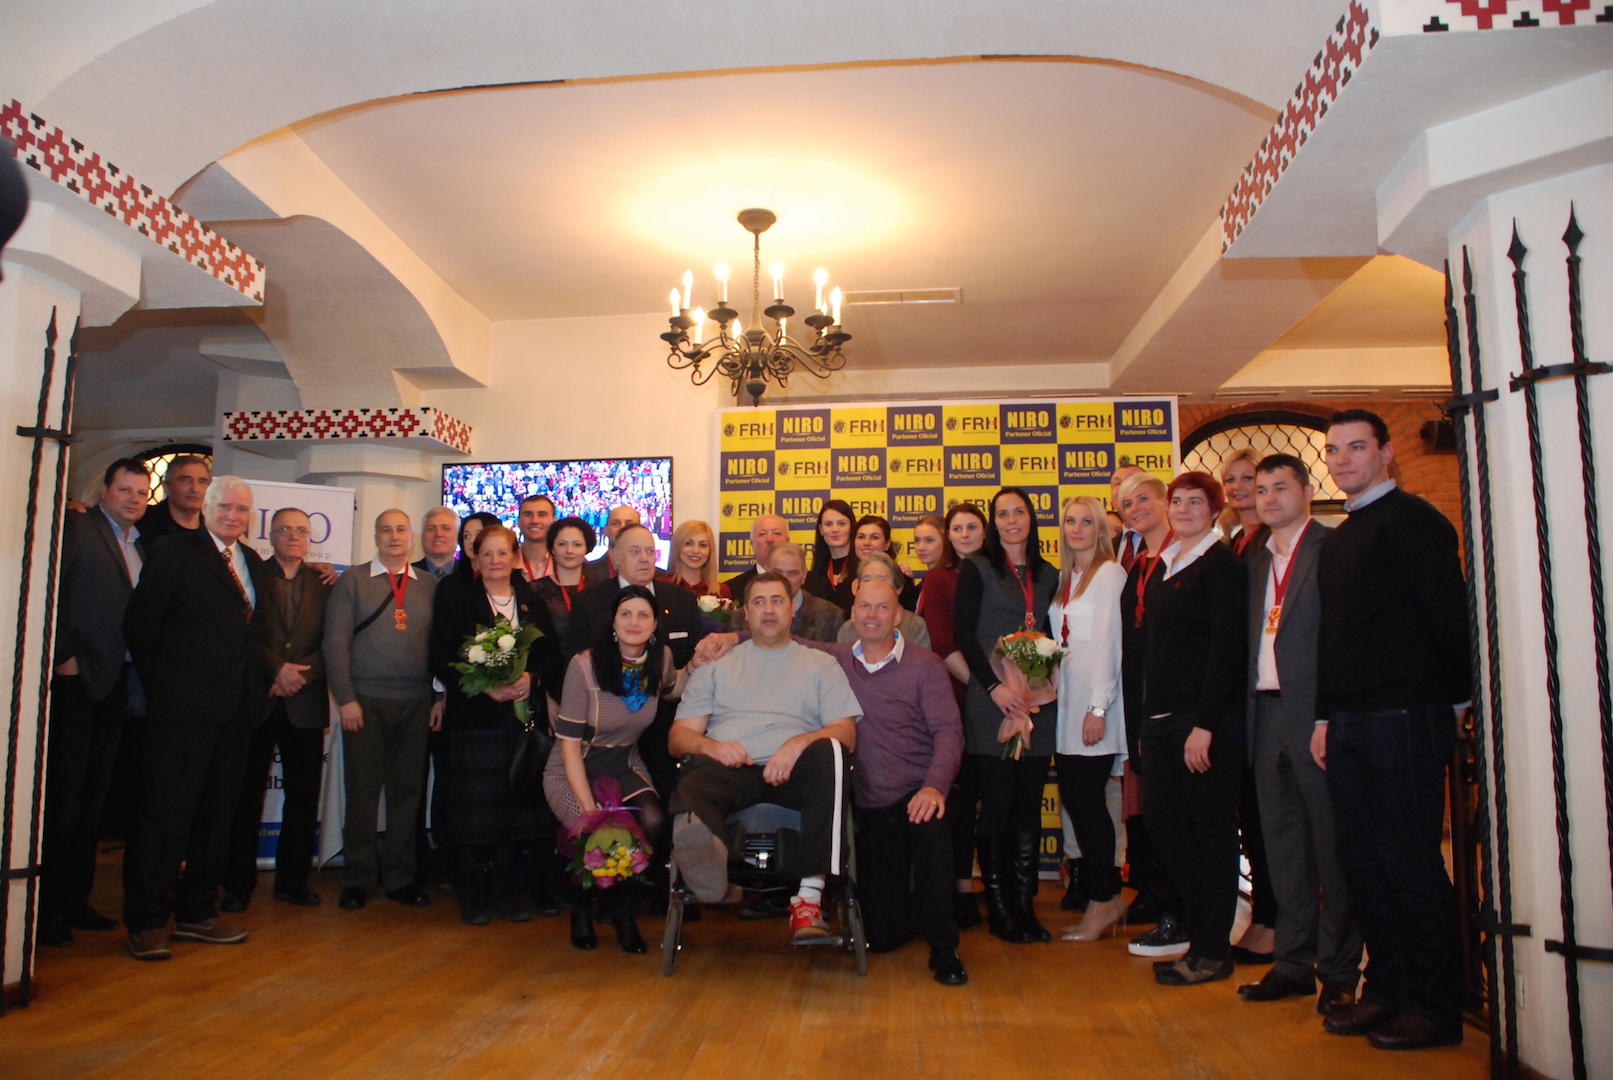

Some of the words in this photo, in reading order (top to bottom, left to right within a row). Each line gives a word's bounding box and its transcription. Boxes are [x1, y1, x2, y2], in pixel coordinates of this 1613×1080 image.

[783, 417, 823, 433] NIRO
[894, 413, 935, 430] NIRO
[963, 417, 997, 430] FRH
[1008, 411, 1048, 428] NIRO
[1077, 415, 1111, 428] FRH
[1122, 409, 1164, 426] NIRO
[740, 423, 773, 436] FRH
[850, 420, 884, 432] FRH
[728, 458, 767, 475] NIRO
[794, 461, 828, 474] FRH
[839, 455, 879, 472] NIRO
[907, 459, 941, 472] FRH
[951, 453, 992, 469] NIRO
[1021, 457, 1055, 470] FRH
[1066, 451, 1108, 468] NIRO
[1136, 455, 1171, 468] FRH
[782, 497, 823, 514] NIRO
[895, 495, 936, 512] NIRO
[1030, 493, 1051, 509] RO
[304, 551, 332, 560] roup
[727, 539, 754, 556] NIR
